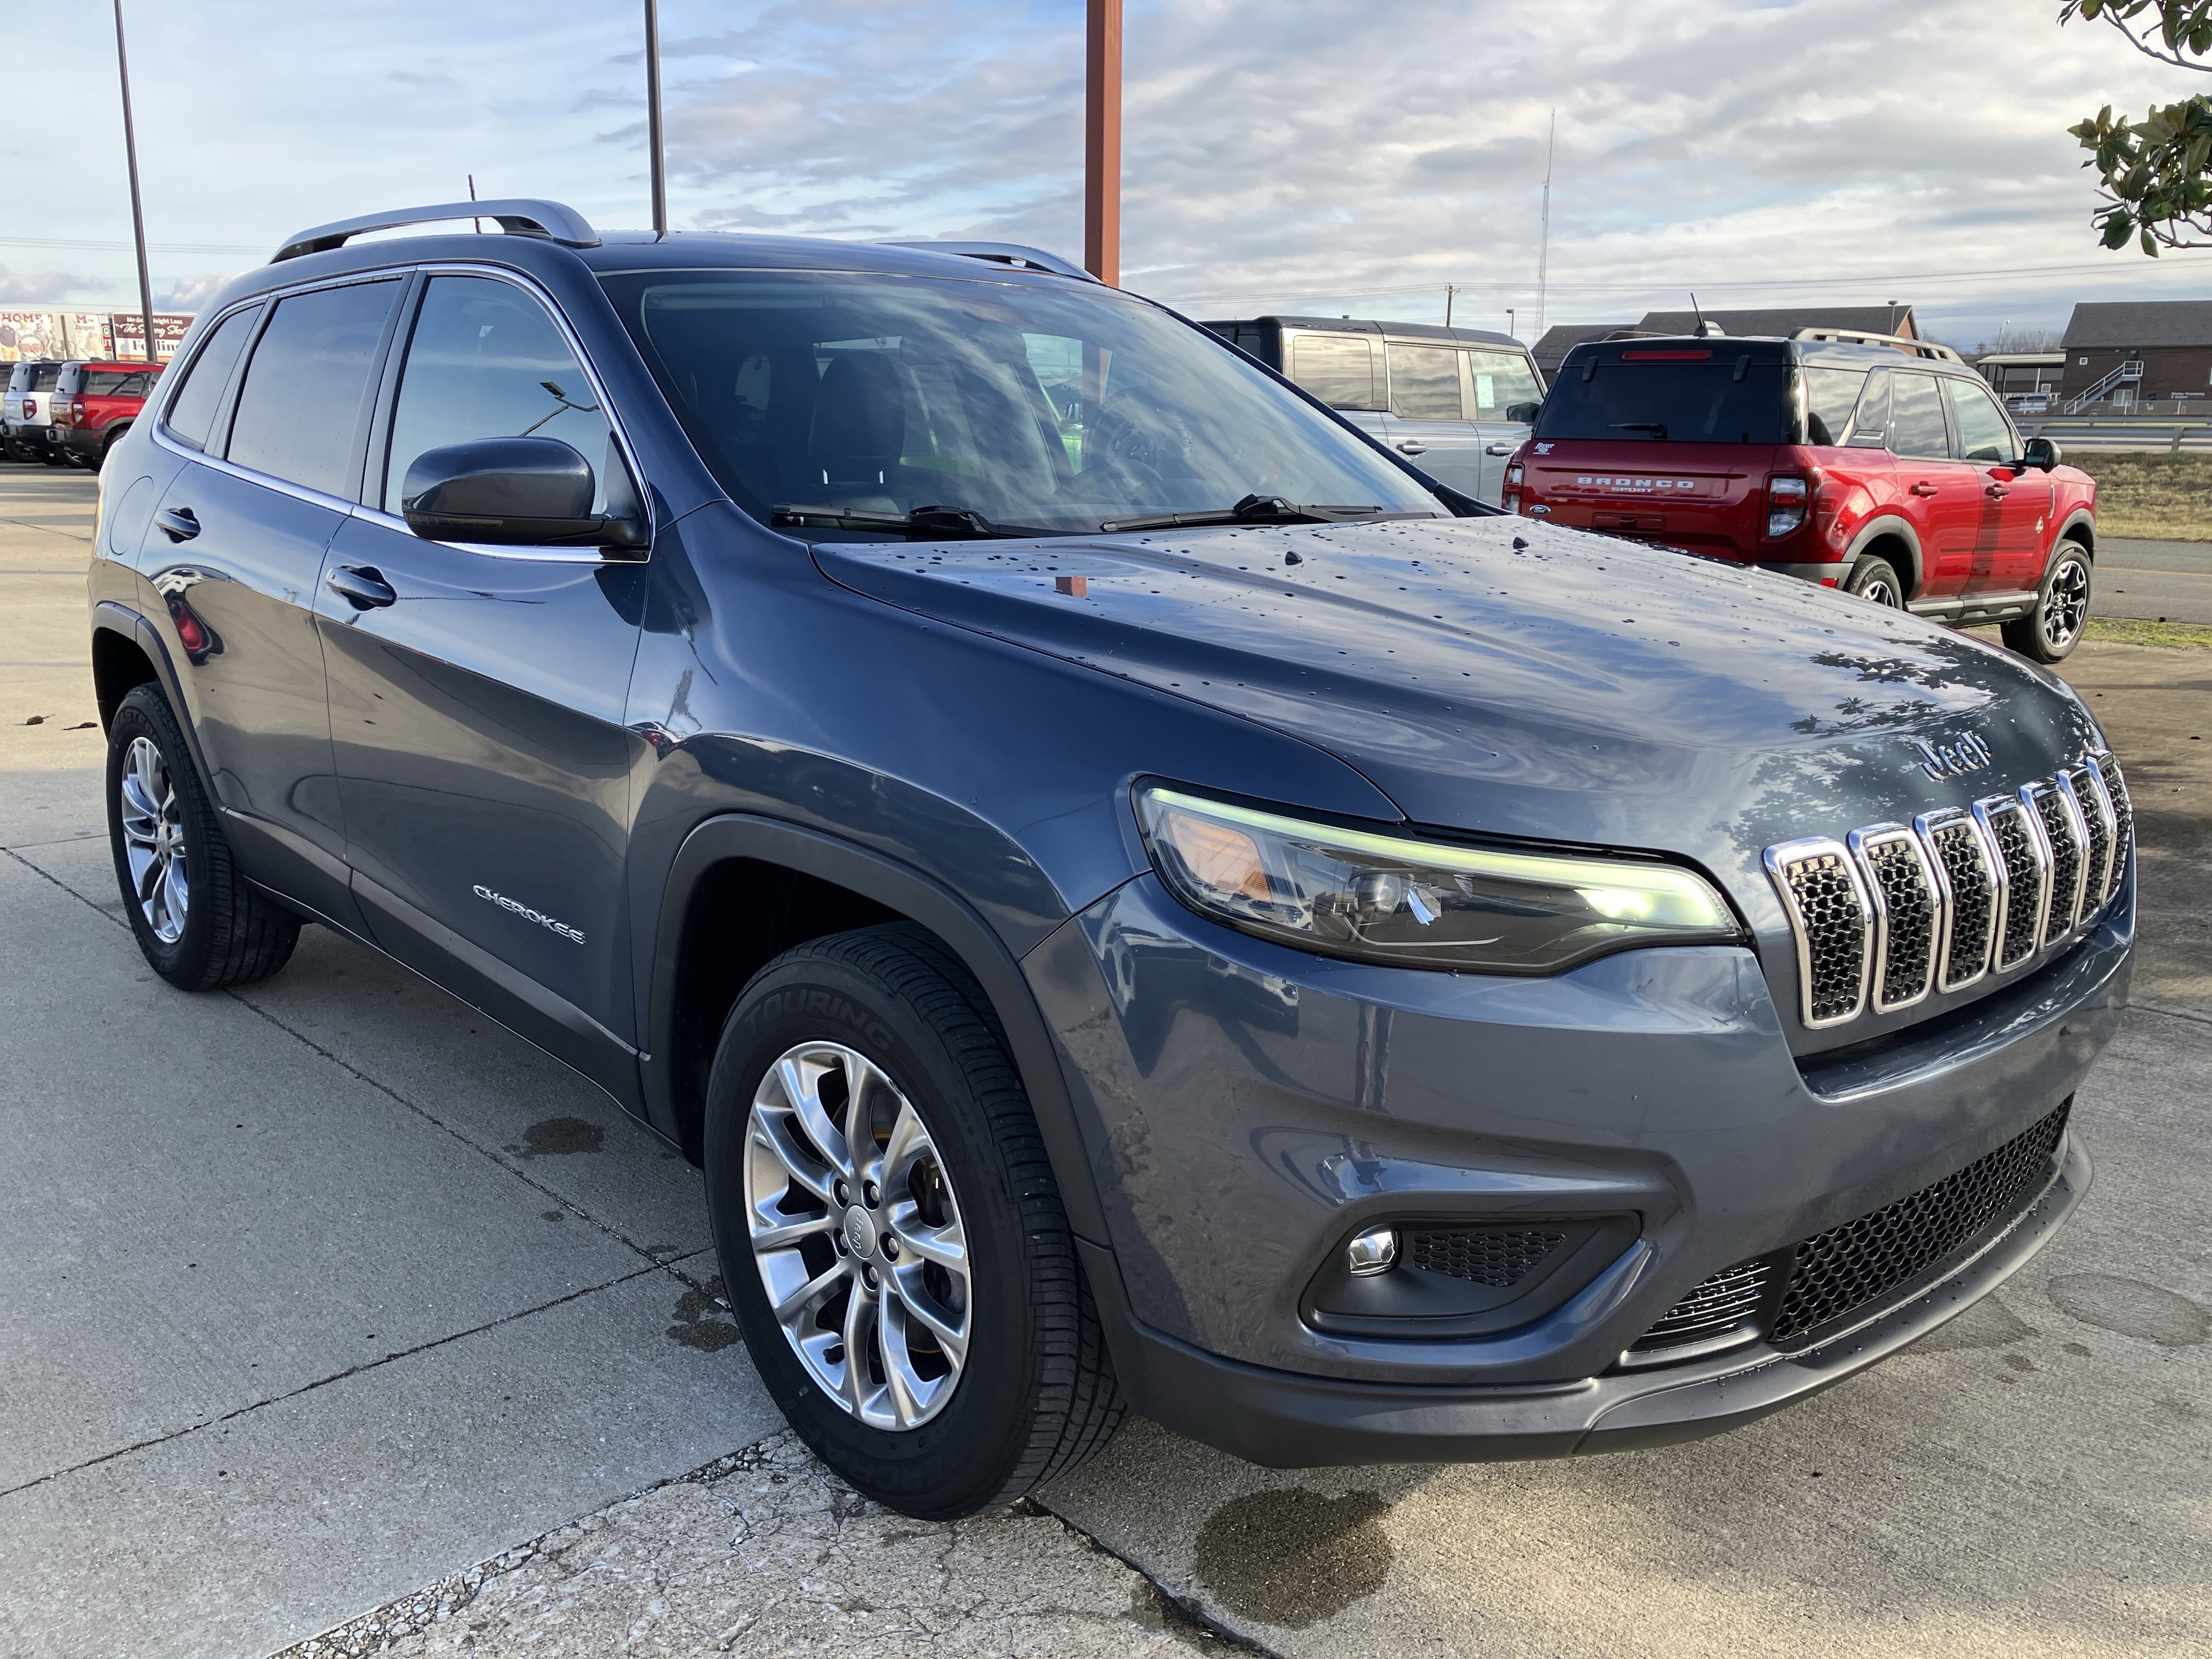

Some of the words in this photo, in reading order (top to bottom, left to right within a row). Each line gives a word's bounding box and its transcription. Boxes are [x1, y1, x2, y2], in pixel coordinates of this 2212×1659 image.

[1, 313, 42, 323] HOME
[1577, 476, 1694, 488] BRONCO
[1916, 730, 1992, 783] Jeep
[472, 884, 586, 945] CHEROKEE
[743, 989, 894, 1051] TOURING
[852, 1212, 864, 1251] Jeep
